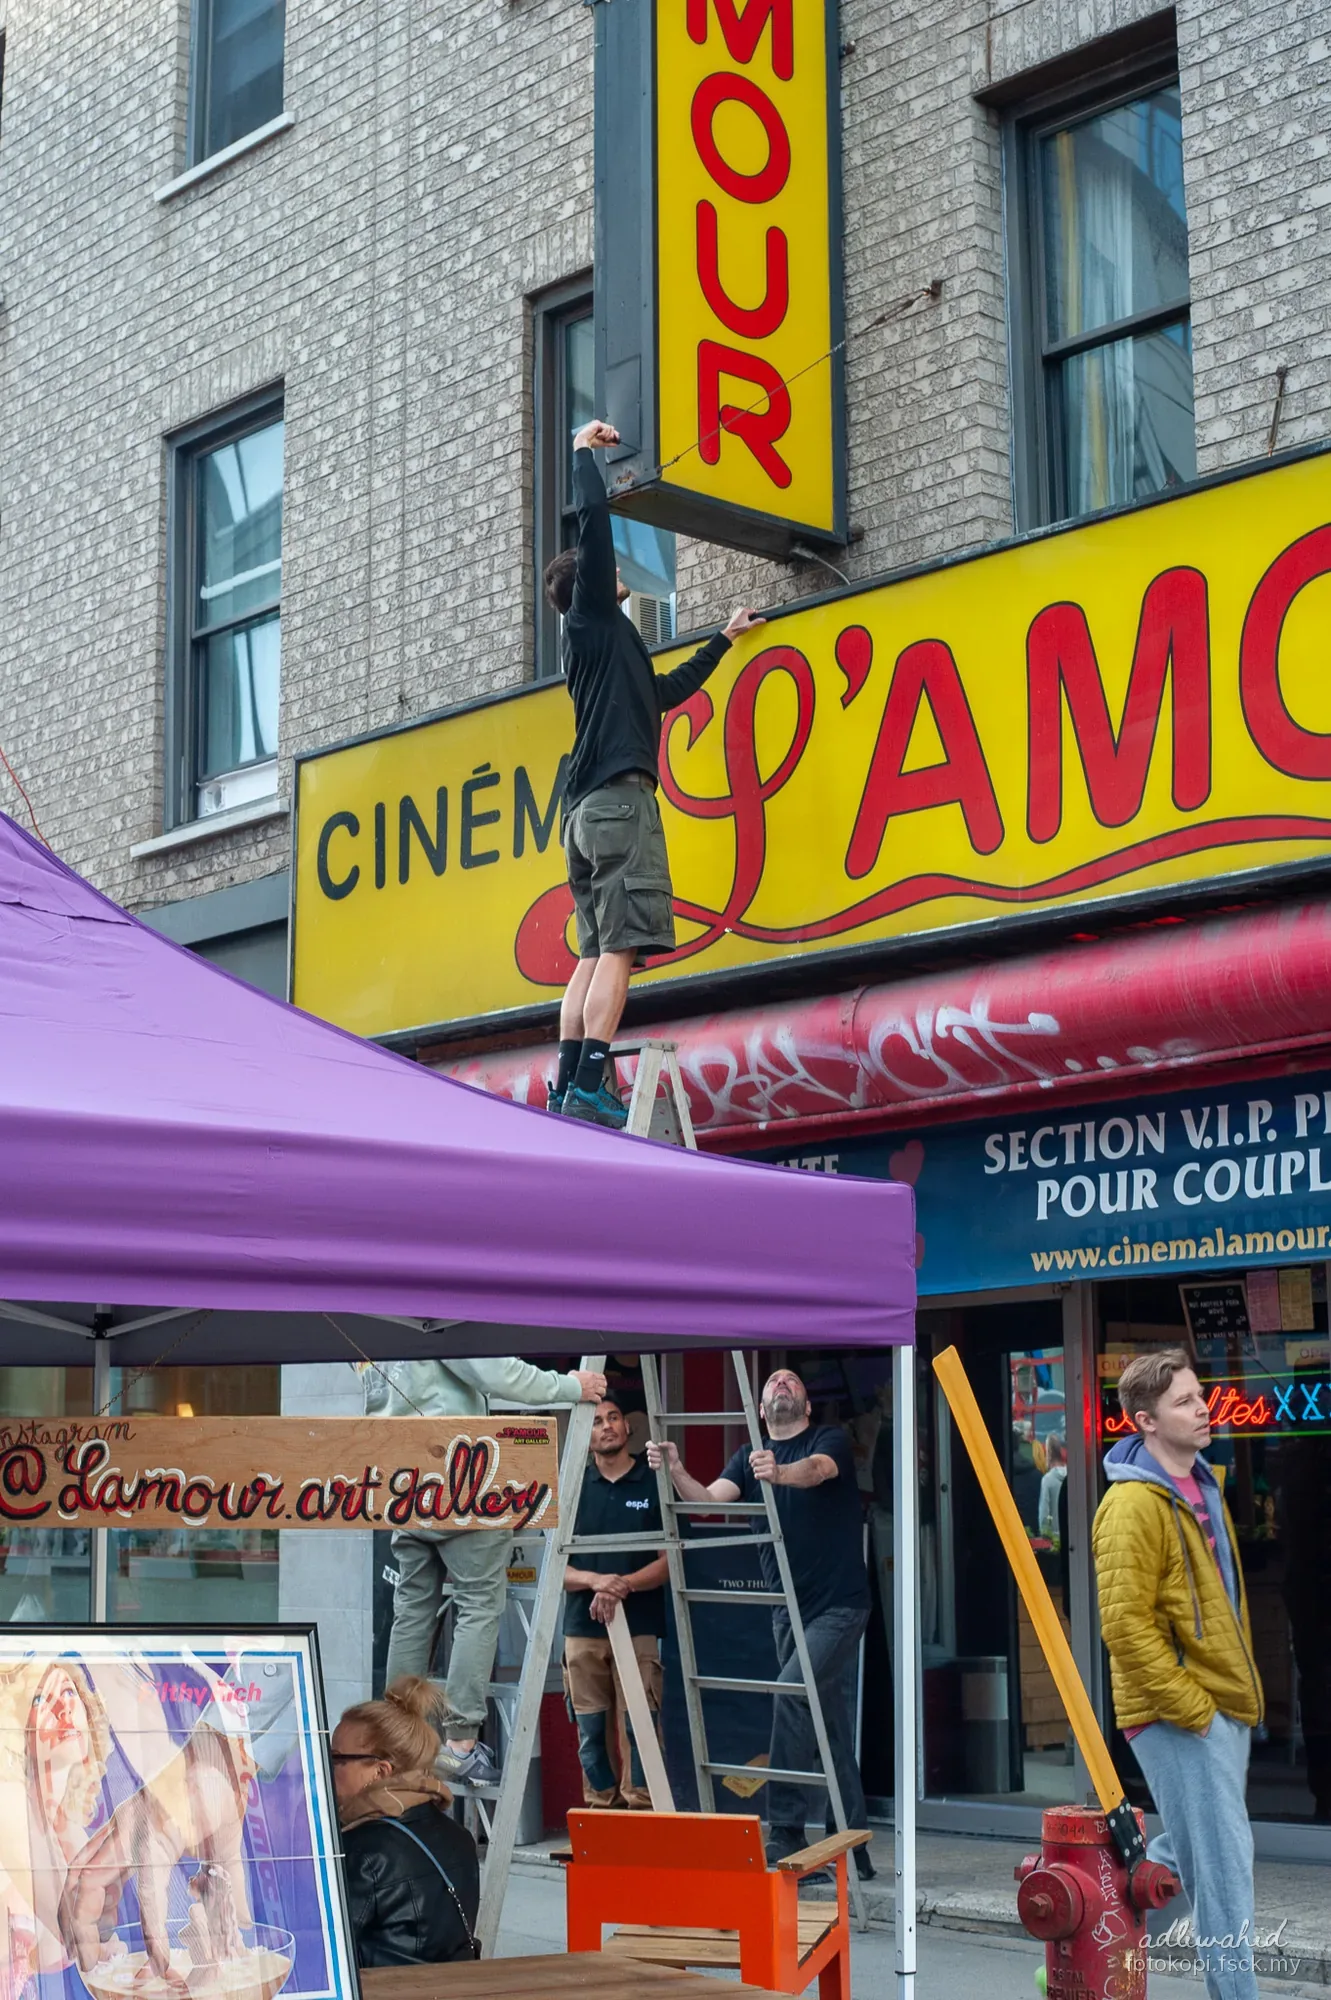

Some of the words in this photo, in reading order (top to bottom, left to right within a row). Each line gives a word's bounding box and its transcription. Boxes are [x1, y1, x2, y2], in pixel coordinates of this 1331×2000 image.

[317, 762, 573, 900] CINÉM
[984, 1111, 1166, 1175] SECTION
[1180, 1099, 1278, 1150] V.I.P.
[1036, 1167, 1160, 1221] POUR
[0, 1420, 137, 1463] nstagram
[625, 1499, 649, 1511] espé
[746, 1580, 771, 1588] THU
